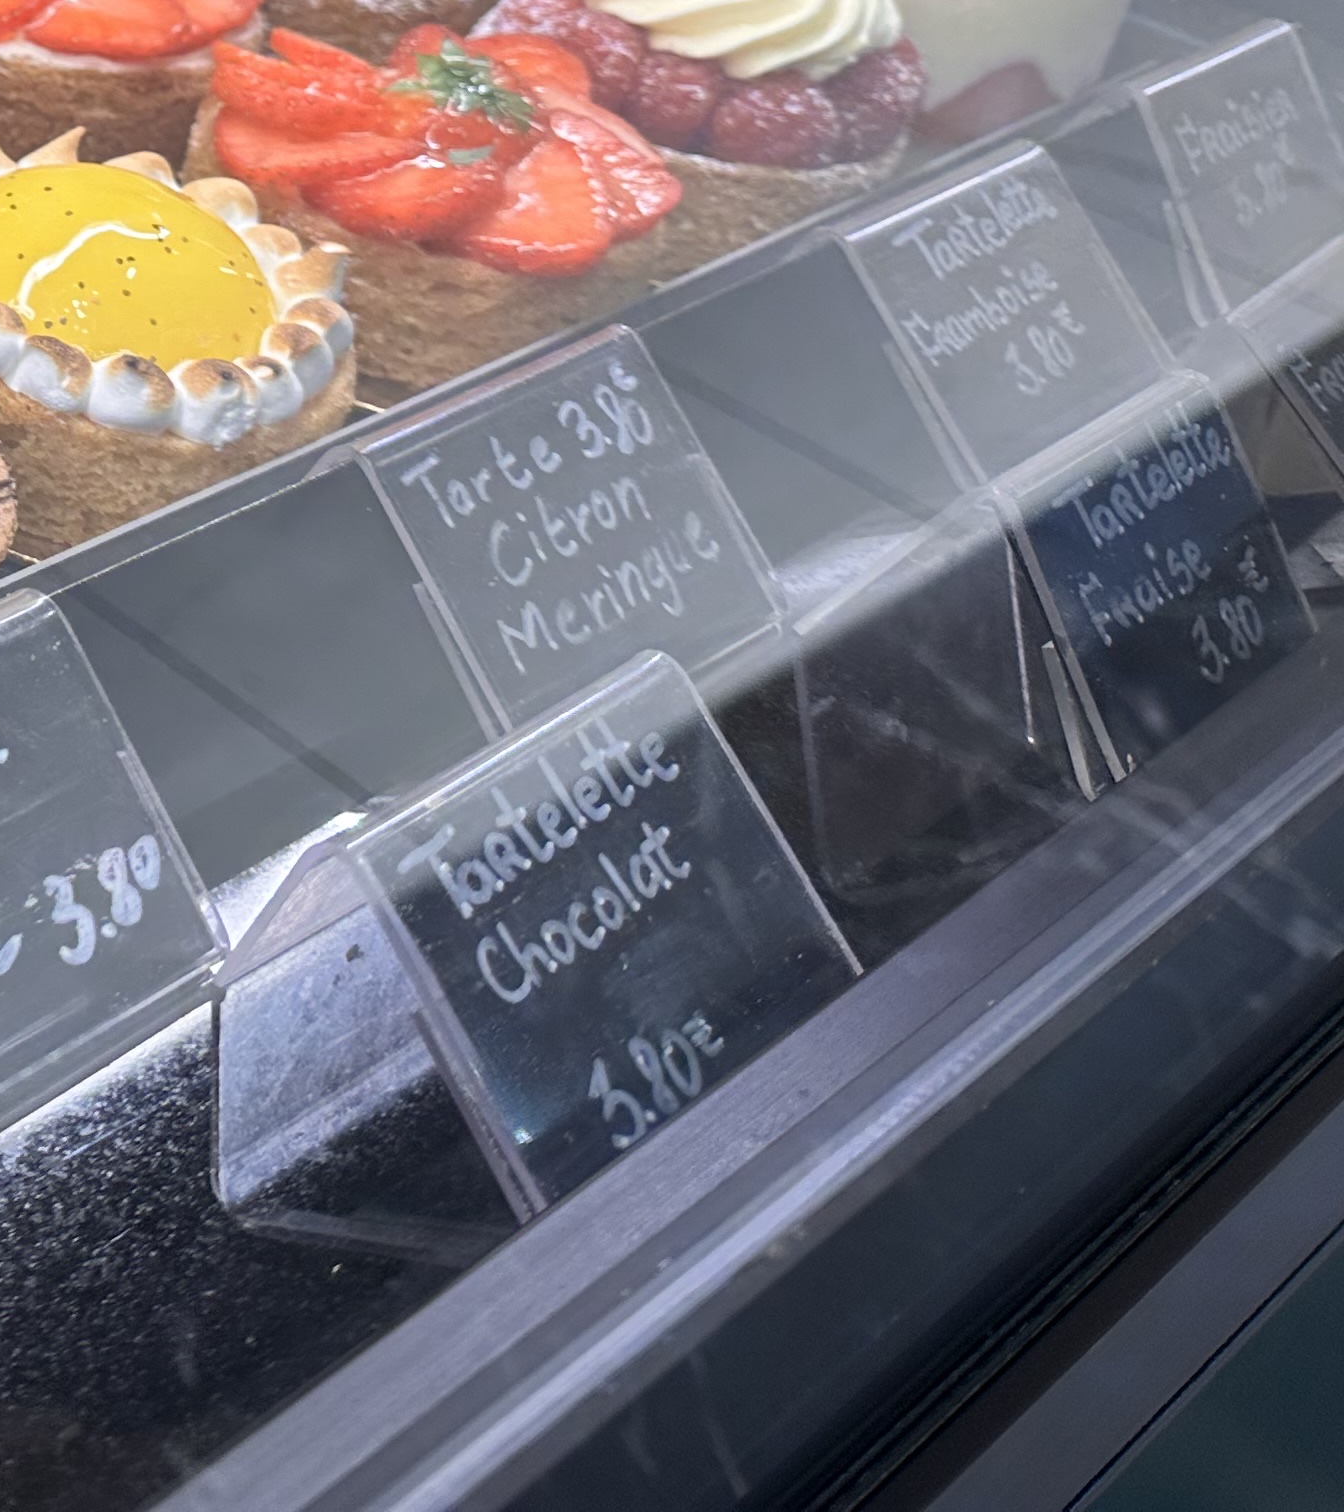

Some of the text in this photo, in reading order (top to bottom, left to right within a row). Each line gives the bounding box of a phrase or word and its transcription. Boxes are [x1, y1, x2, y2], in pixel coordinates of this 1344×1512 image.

[400, 435, 562, 529] Tarte
[490, 476, 653, 586] Citron
[497, 511, 720, 675] Meringue
[1079, 539, 1211, 647] Fraise
[44, 834, 161, 967] 3.80
